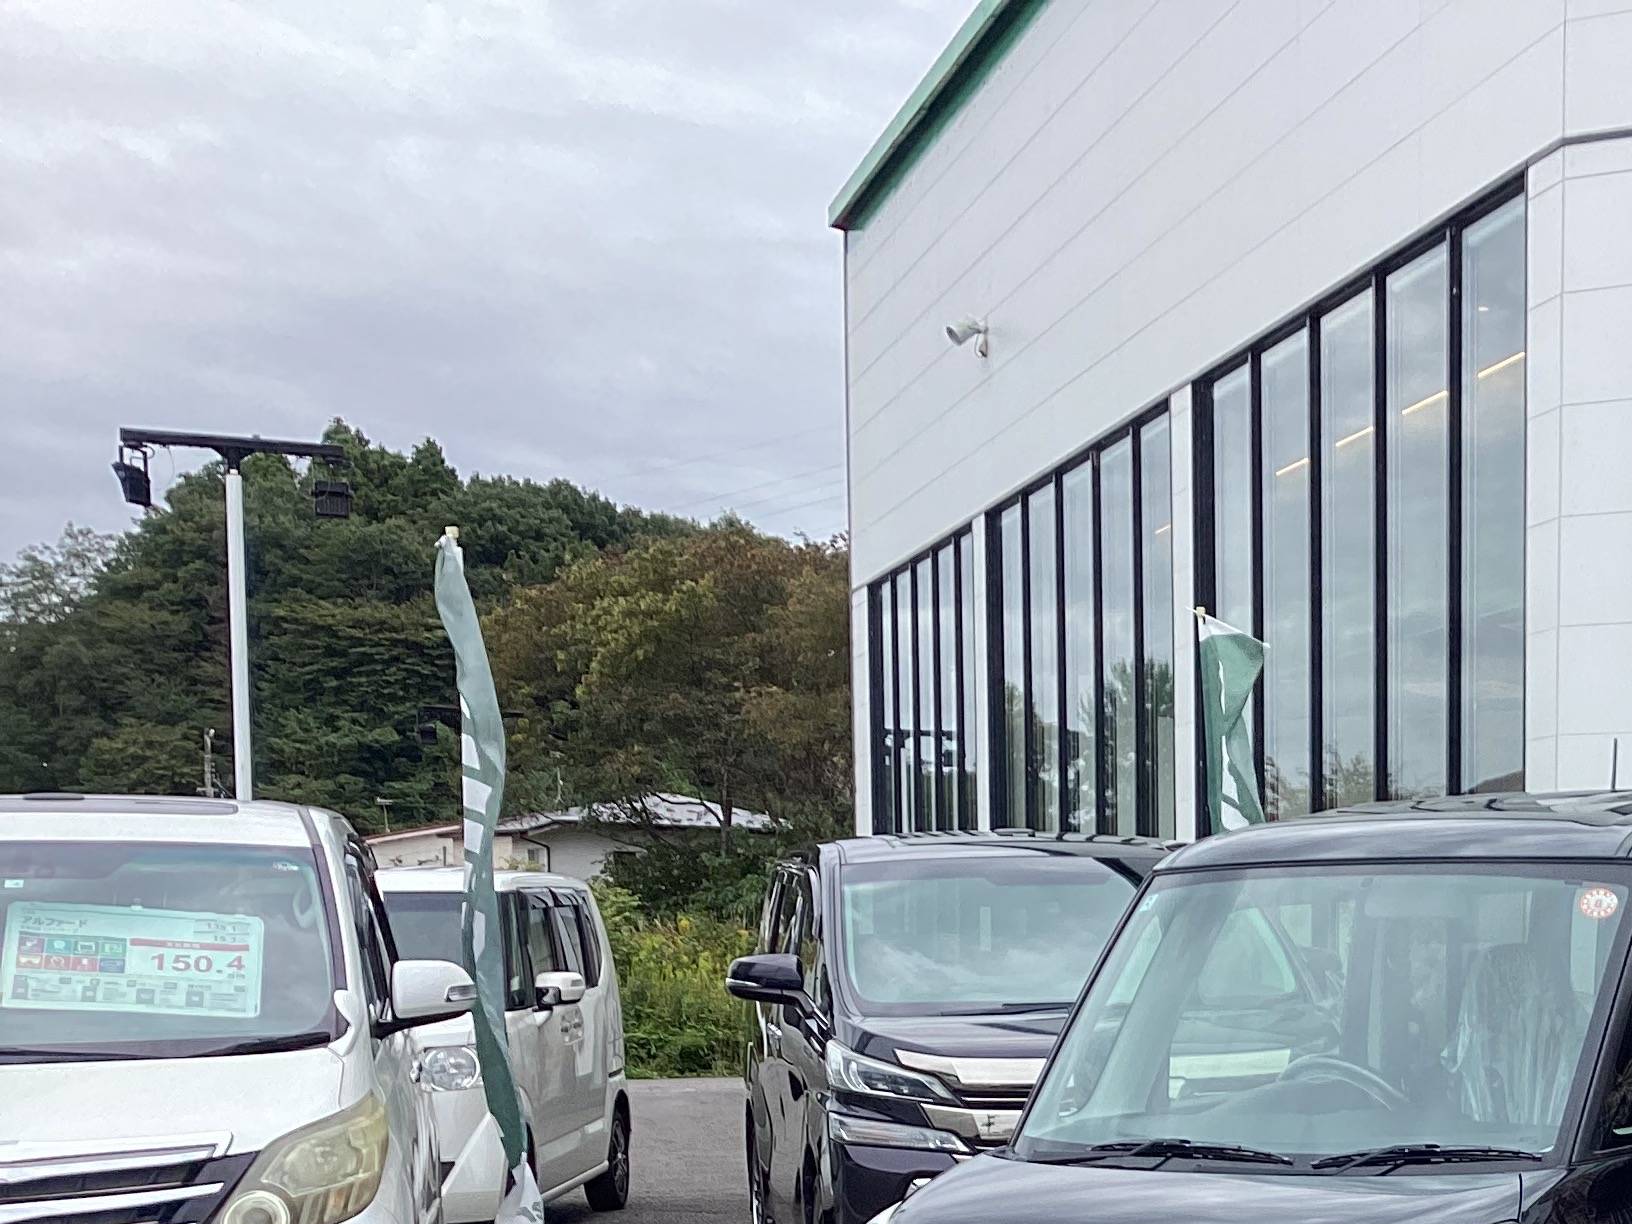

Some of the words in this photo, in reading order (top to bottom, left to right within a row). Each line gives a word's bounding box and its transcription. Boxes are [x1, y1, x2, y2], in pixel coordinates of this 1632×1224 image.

[21, 915, 88, 928] アルファード
[151, 953, 246, 974] 150.4
